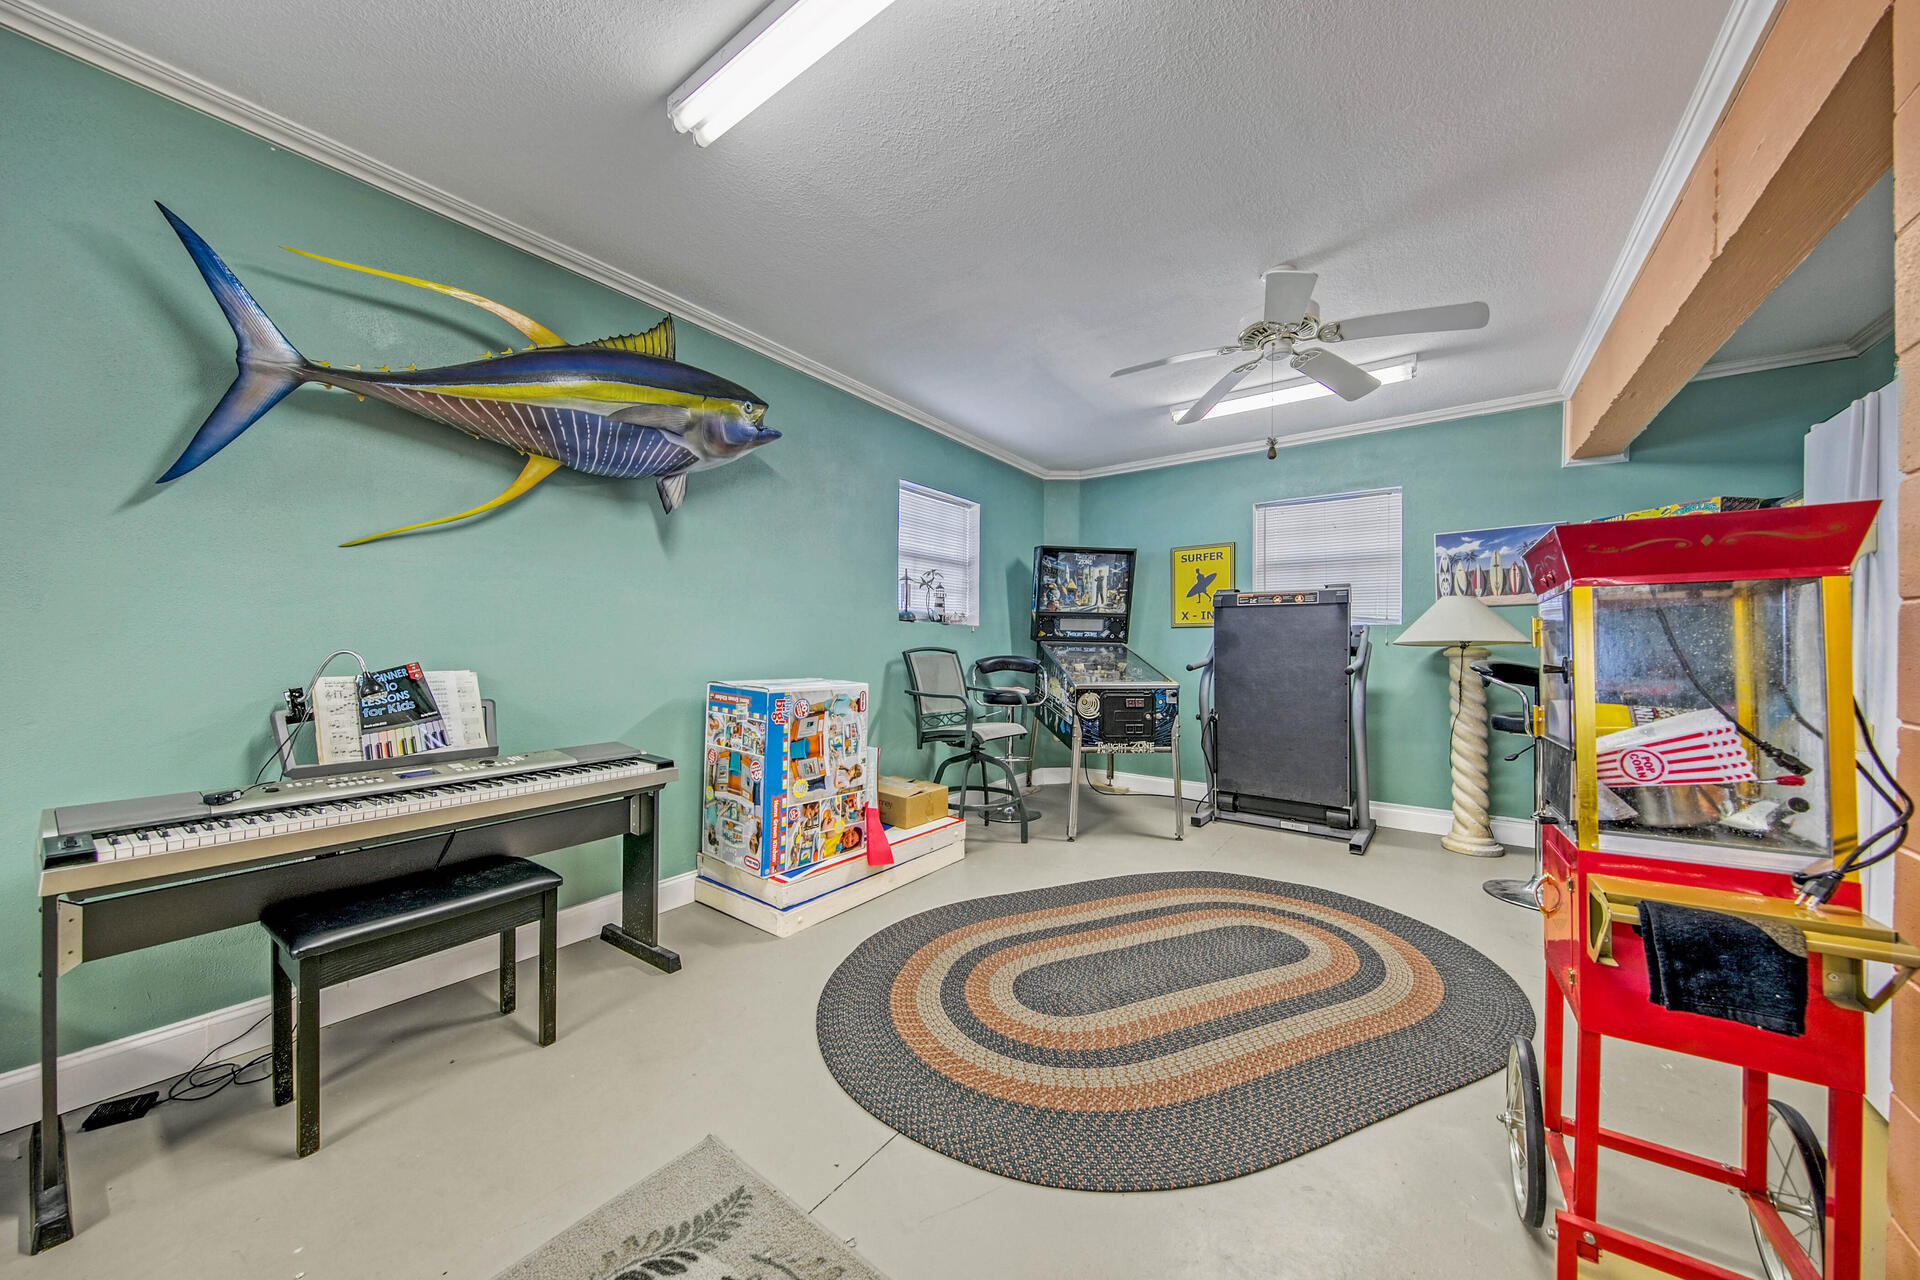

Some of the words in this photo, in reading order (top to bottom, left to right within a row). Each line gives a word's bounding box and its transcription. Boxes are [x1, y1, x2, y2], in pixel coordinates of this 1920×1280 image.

[1181, 551, 1224, 563] SURFER
[1181, 611, 1189, 620] X
[1201, 610, 1215, 620] IN
[361, 690, 410, 707] LESSONS
[362, 707, 387, 718] for
[387, 700, 416, 714] Kids
[771, 699, 787, 724] big!
[1130, 741, 1155, 752] ZONE
[1629, 753, 1647, 778] CORN
[1641, 756, 1656, 774] POP
